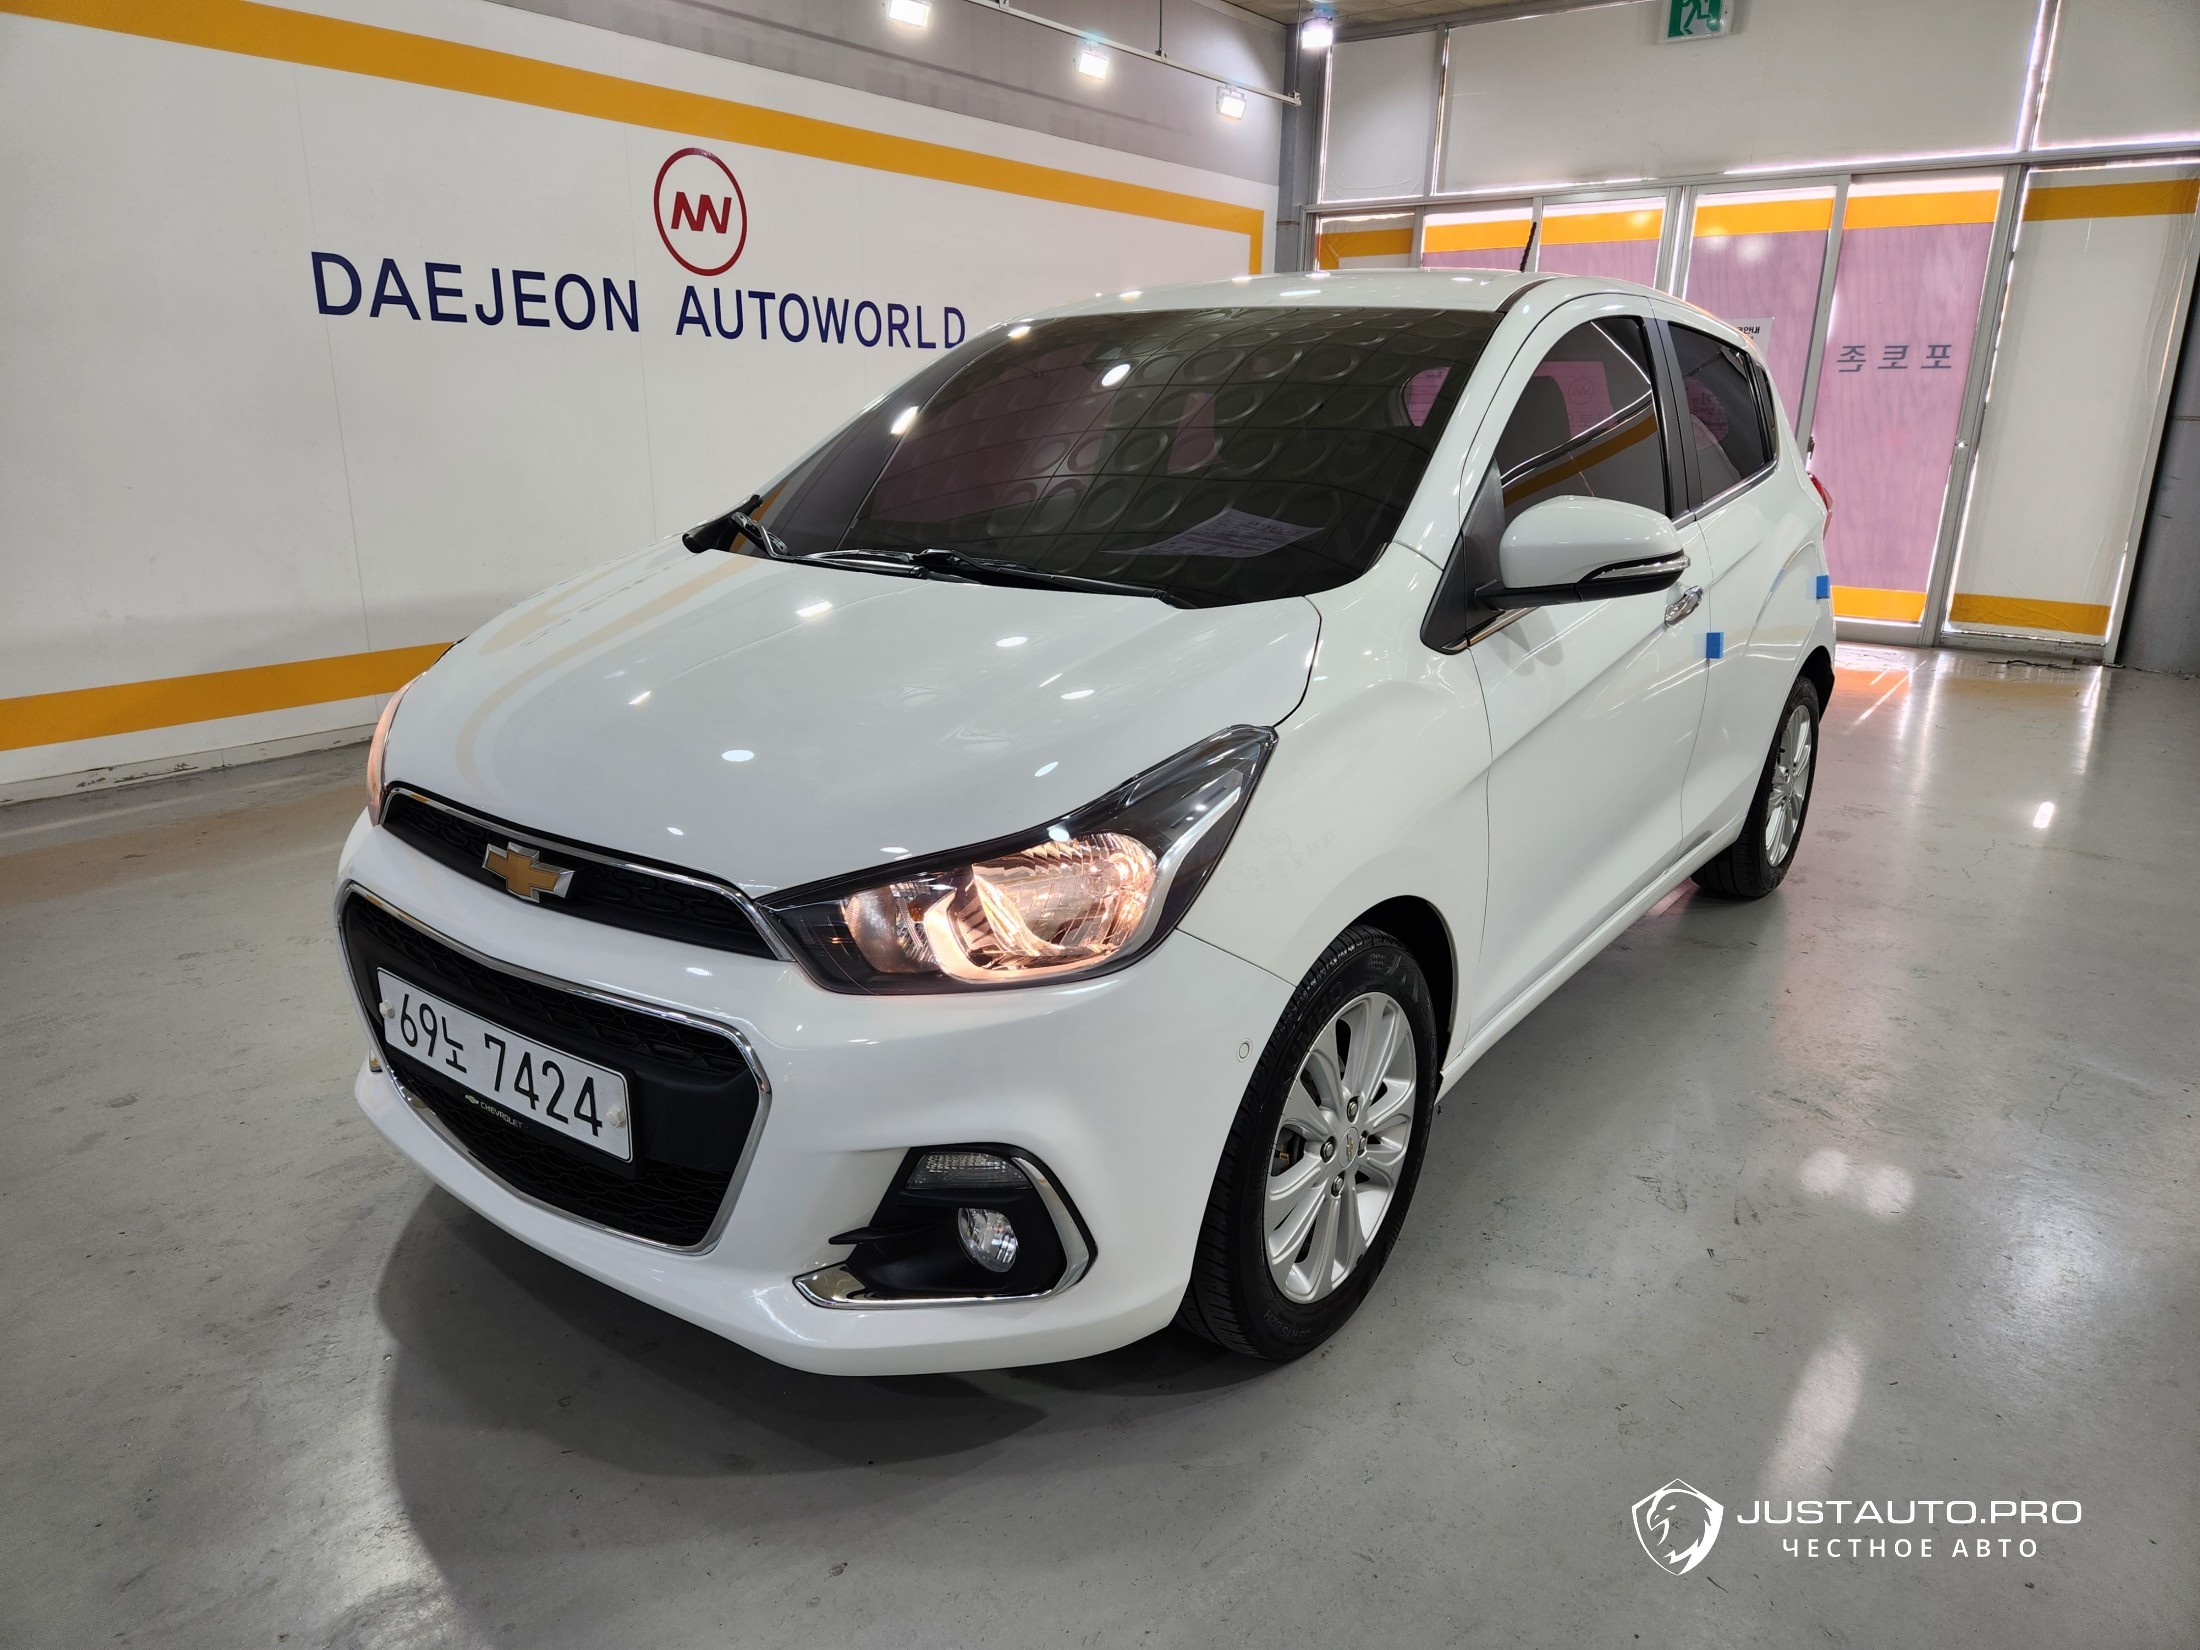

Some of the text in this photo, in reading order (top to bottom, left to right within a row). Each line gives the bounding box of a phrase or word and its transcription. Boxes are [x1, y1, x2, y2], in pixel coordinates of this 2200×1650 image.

[310, 251, 966, 349] DAEJEON AUTOWORLD
[400, 993, 603, 1137] 69노 7424
[480, 1101, 523, 1129] CHEVROLET
